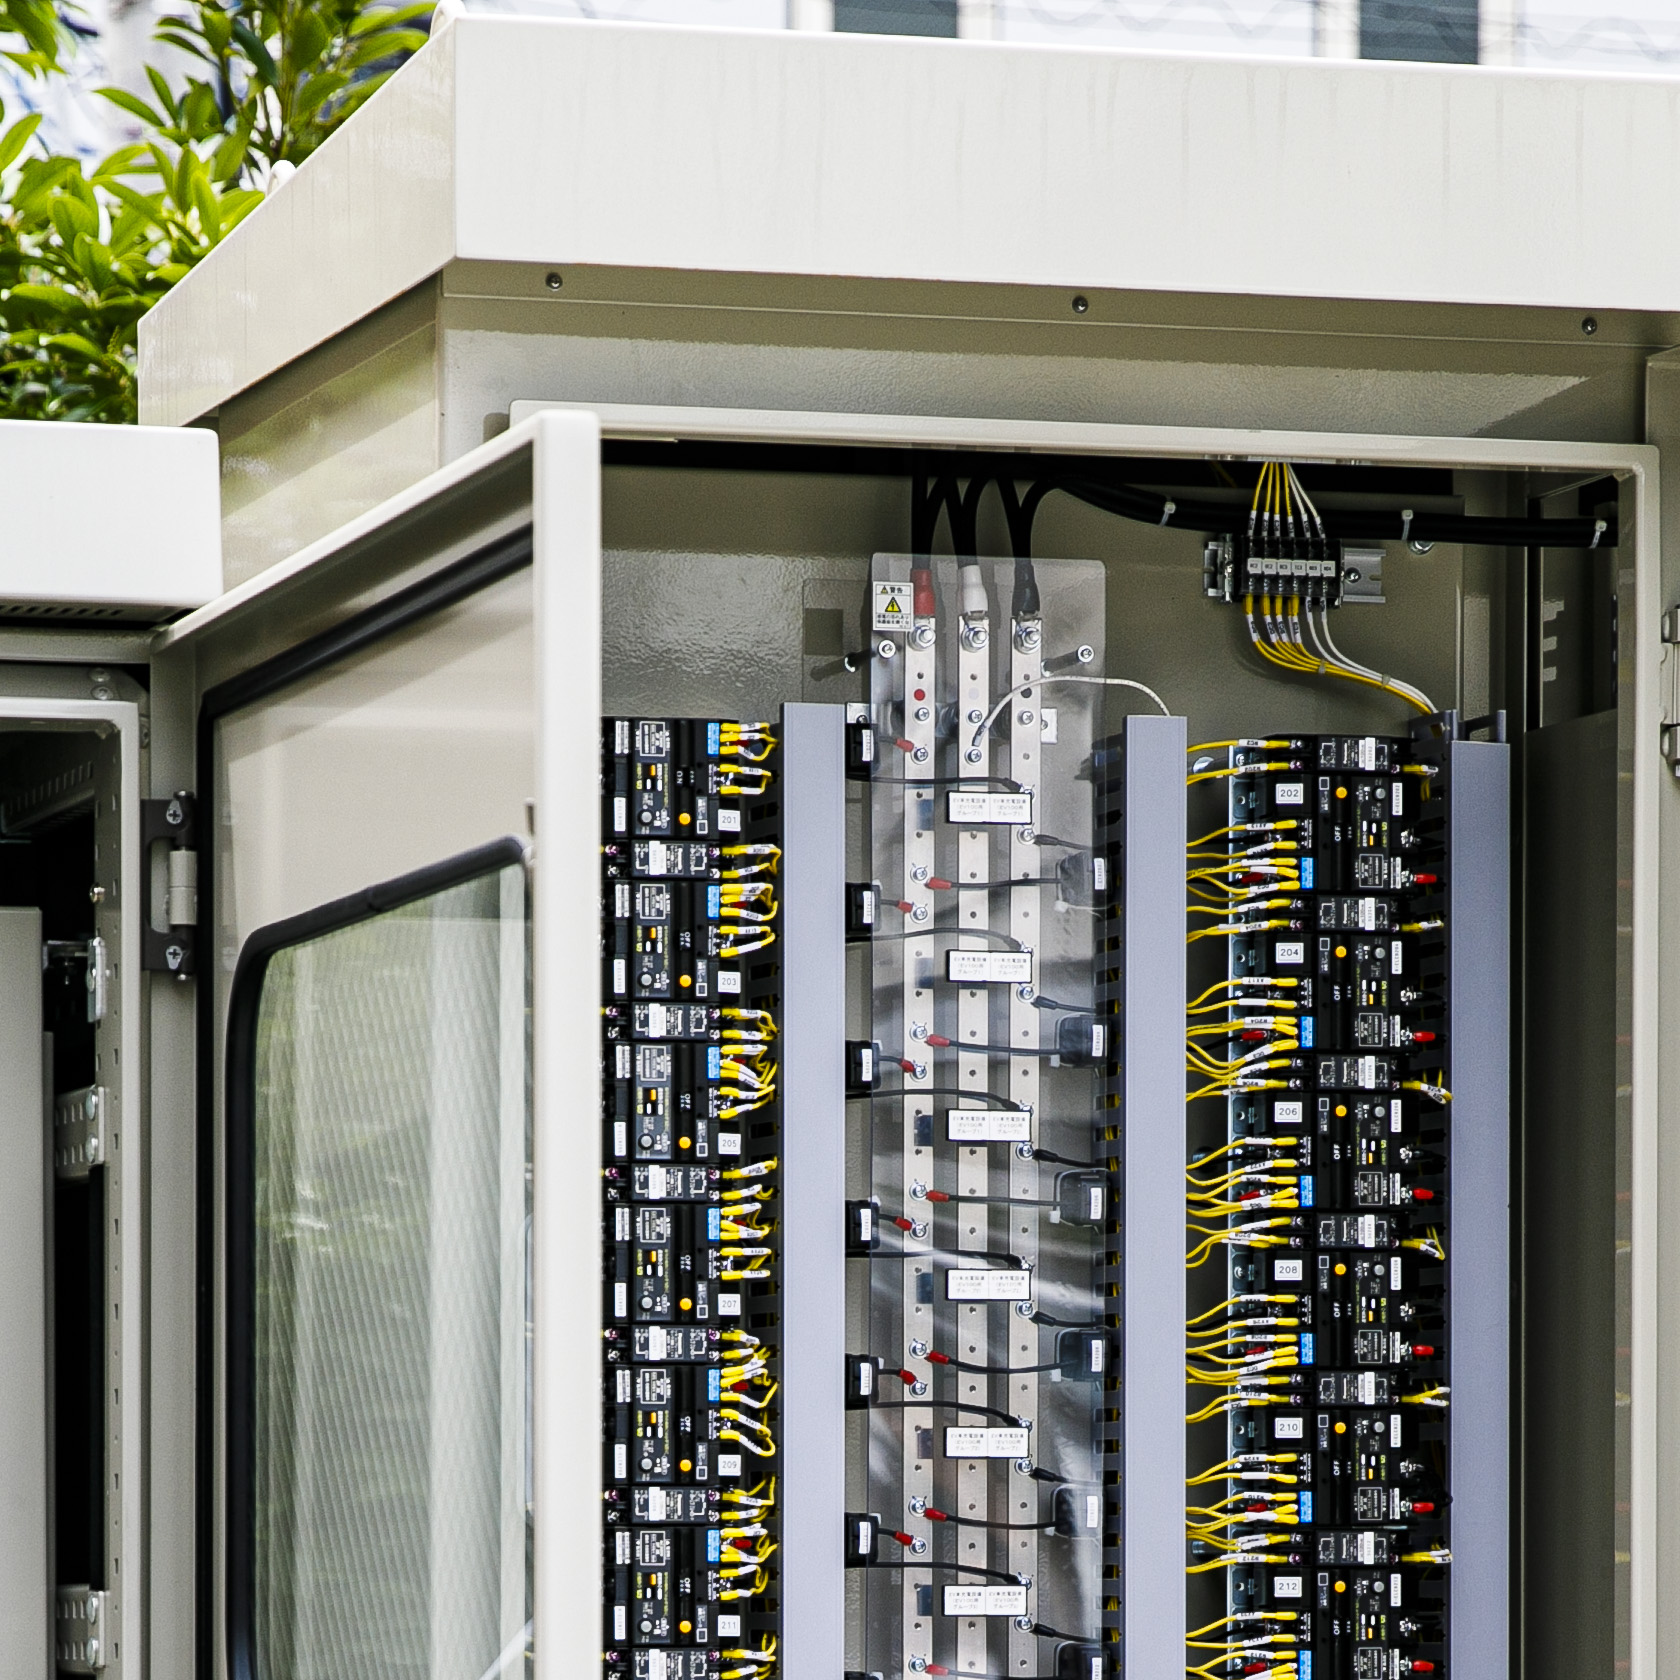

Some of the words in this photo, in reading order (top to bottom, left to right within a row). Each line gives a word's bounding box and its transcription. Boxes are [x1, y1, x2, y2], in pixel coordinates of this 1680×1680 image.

[1279, 788, 1299, 798] 202
[722, 815, 737, 824] 201
[1279, 948, 1299, 958] 204
[722, 977, 737, 986] 203
[1278, 1107, 1298, 1117] 206
[722, 1138, 737, 1148] 205
[1278, 1265, 1298, 1275] 208
[722, 1299, 737, 1309] 207
[1278, 1422, 1298, 1432] 210
[722, 1460, 737, 1469] 209
[1277, 1581, 1297, 1591] 212
[722, 1620, 737, 1630] 211
